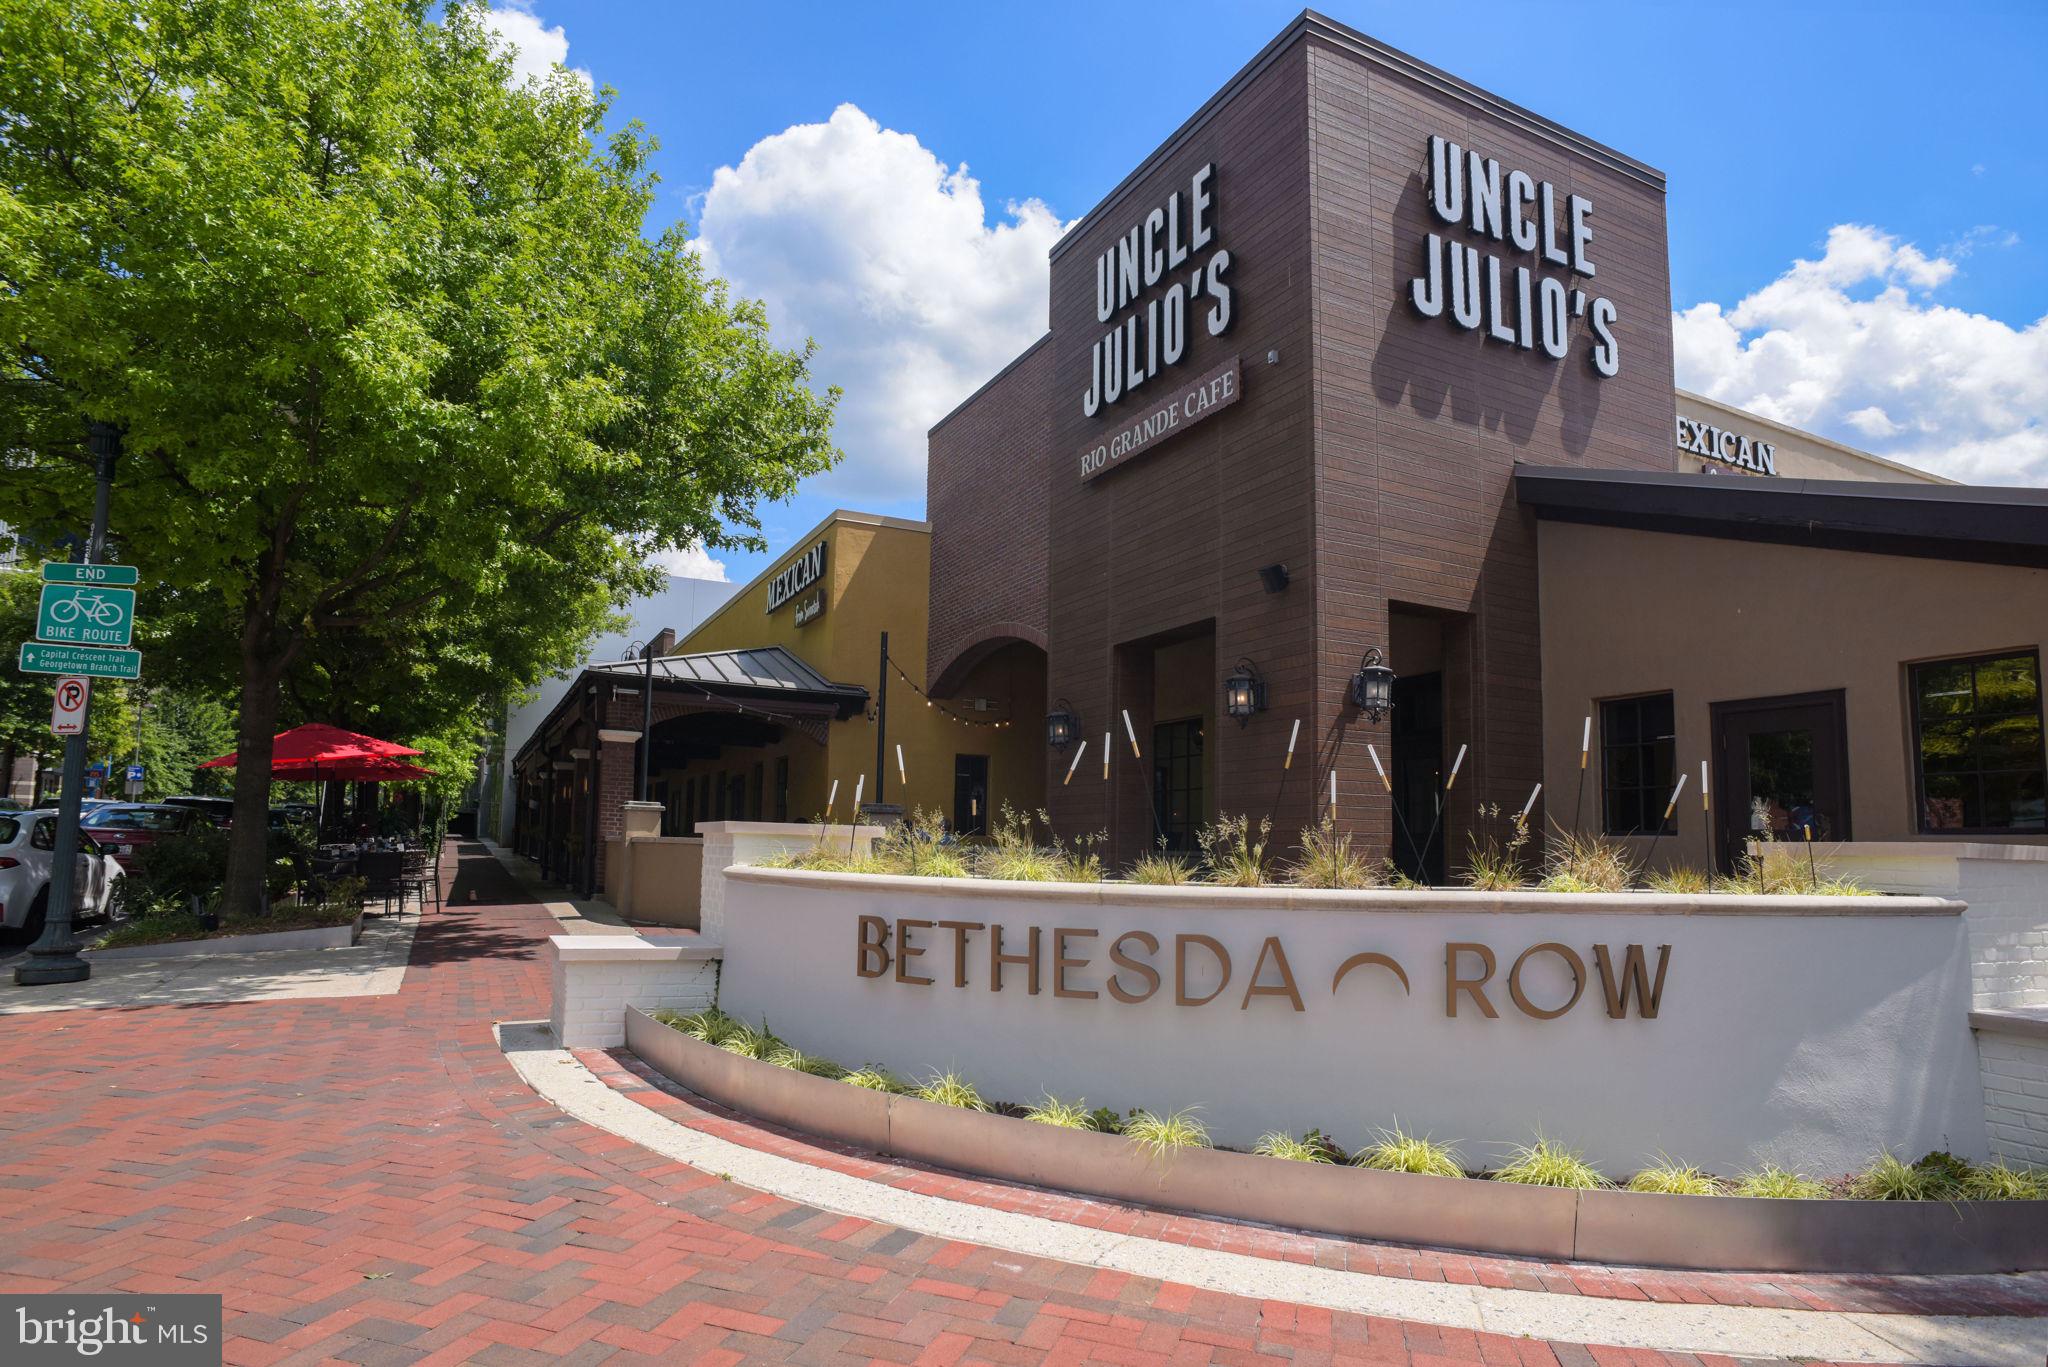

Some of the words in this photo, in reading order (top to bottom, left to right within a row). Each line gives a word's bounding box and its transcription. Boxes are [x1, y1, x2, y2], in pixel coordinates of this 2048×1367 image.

[1097, 162, 1213, 323] UNCLE
[1430, 135, 1595, 279] UNCLE
[1084, 249, 1231, 418] JULIO'S
[1410, 233, 1619, 378] JULIO'S
[1080, 445, 1106, 477] RIO
[1110, 402, 1179, 460] GRANDE
[1184, 370, 1234, 418] CAFE
[75, 568, 106, 579] END
[766, 541, 824, 614] MEXICAN
[39, 659, 88, 671] Georgetown
[90, 663, 117, 672] Branch
[120, 665, 137, 673] Trail
[40, 649, 69, 660] Capital
[72, 652, 106, 662] Crescent
[108, 654, 126, 663] Trail
[46, 626, 75, 639] BIKE
[82, 628, 122, 641] ROUTE
[857, 914, 1306, 1012] BETHESDA
[1445, 942, 1673, 1020] ROW
